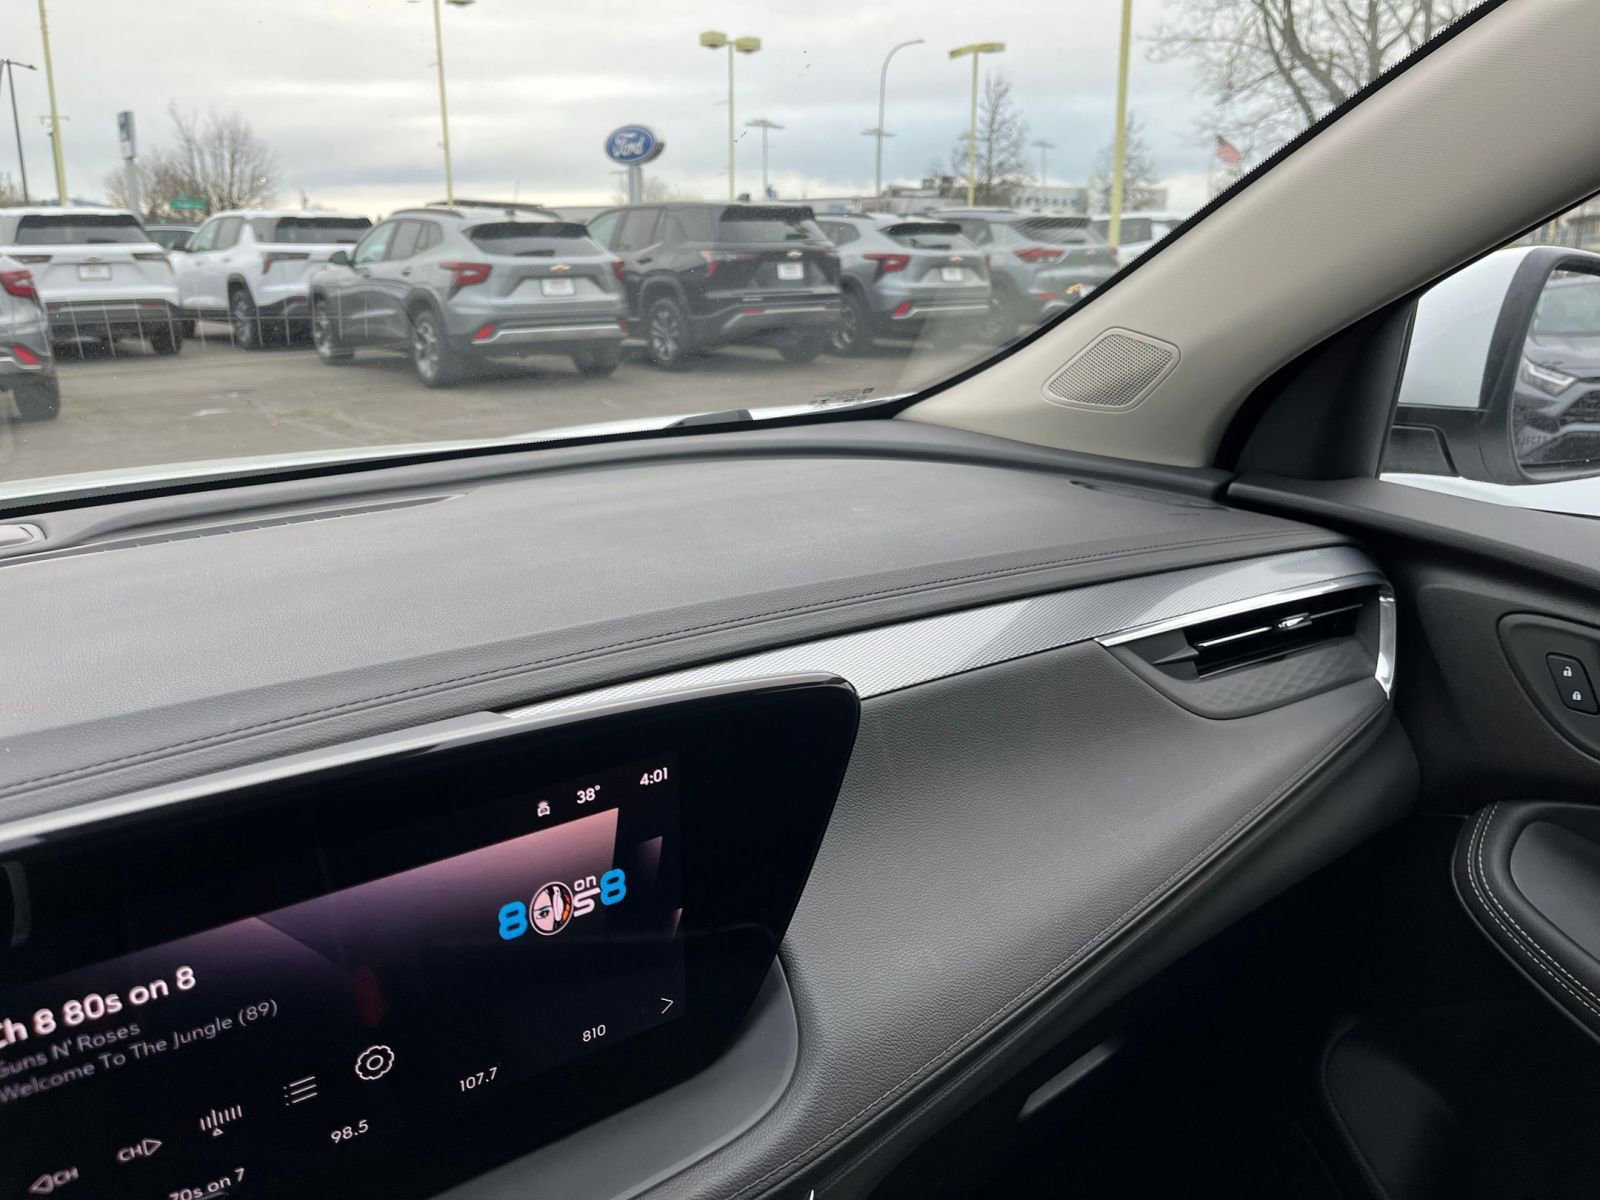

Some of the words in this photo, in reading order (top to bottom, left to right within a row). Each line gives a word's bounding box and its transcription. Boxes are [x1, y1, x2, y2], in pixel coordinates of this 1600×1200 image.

[611, 132, 646, 158] Ford
[640, 767, 668, 786] 4:01
[573, 875, 597, 892] on
[600, 868, 627, 906] 8
[33, 1008, 57, 1036] 8
[63, 992, 123, 1027] 80s
[128, 978, 169, 1006] on
[175, 965, 196, 991] 8
[51, 1038, 73, 1061] N'
[77, 1022, 141, 1052] Roses
[582, 1024, 606, 1042] 810
[0, 1062, 96, 1104] Welcome
[98, 1052, 127, 1070] To
[129, 1040, 168, 1060] The
[172, 1017, 233, 1050] Jungle
[238, 999, 278, 1027] (89)
[459, 1066, 498, 1092] 107.7
[331, 1119, 369, 1143] 98.5
[117, 1144, 144, 1162] CH
[52, 1166, 79, 1187] CH
[207, 1176, 231, 1194] on
[234, 1166, 245, 1182] 7
